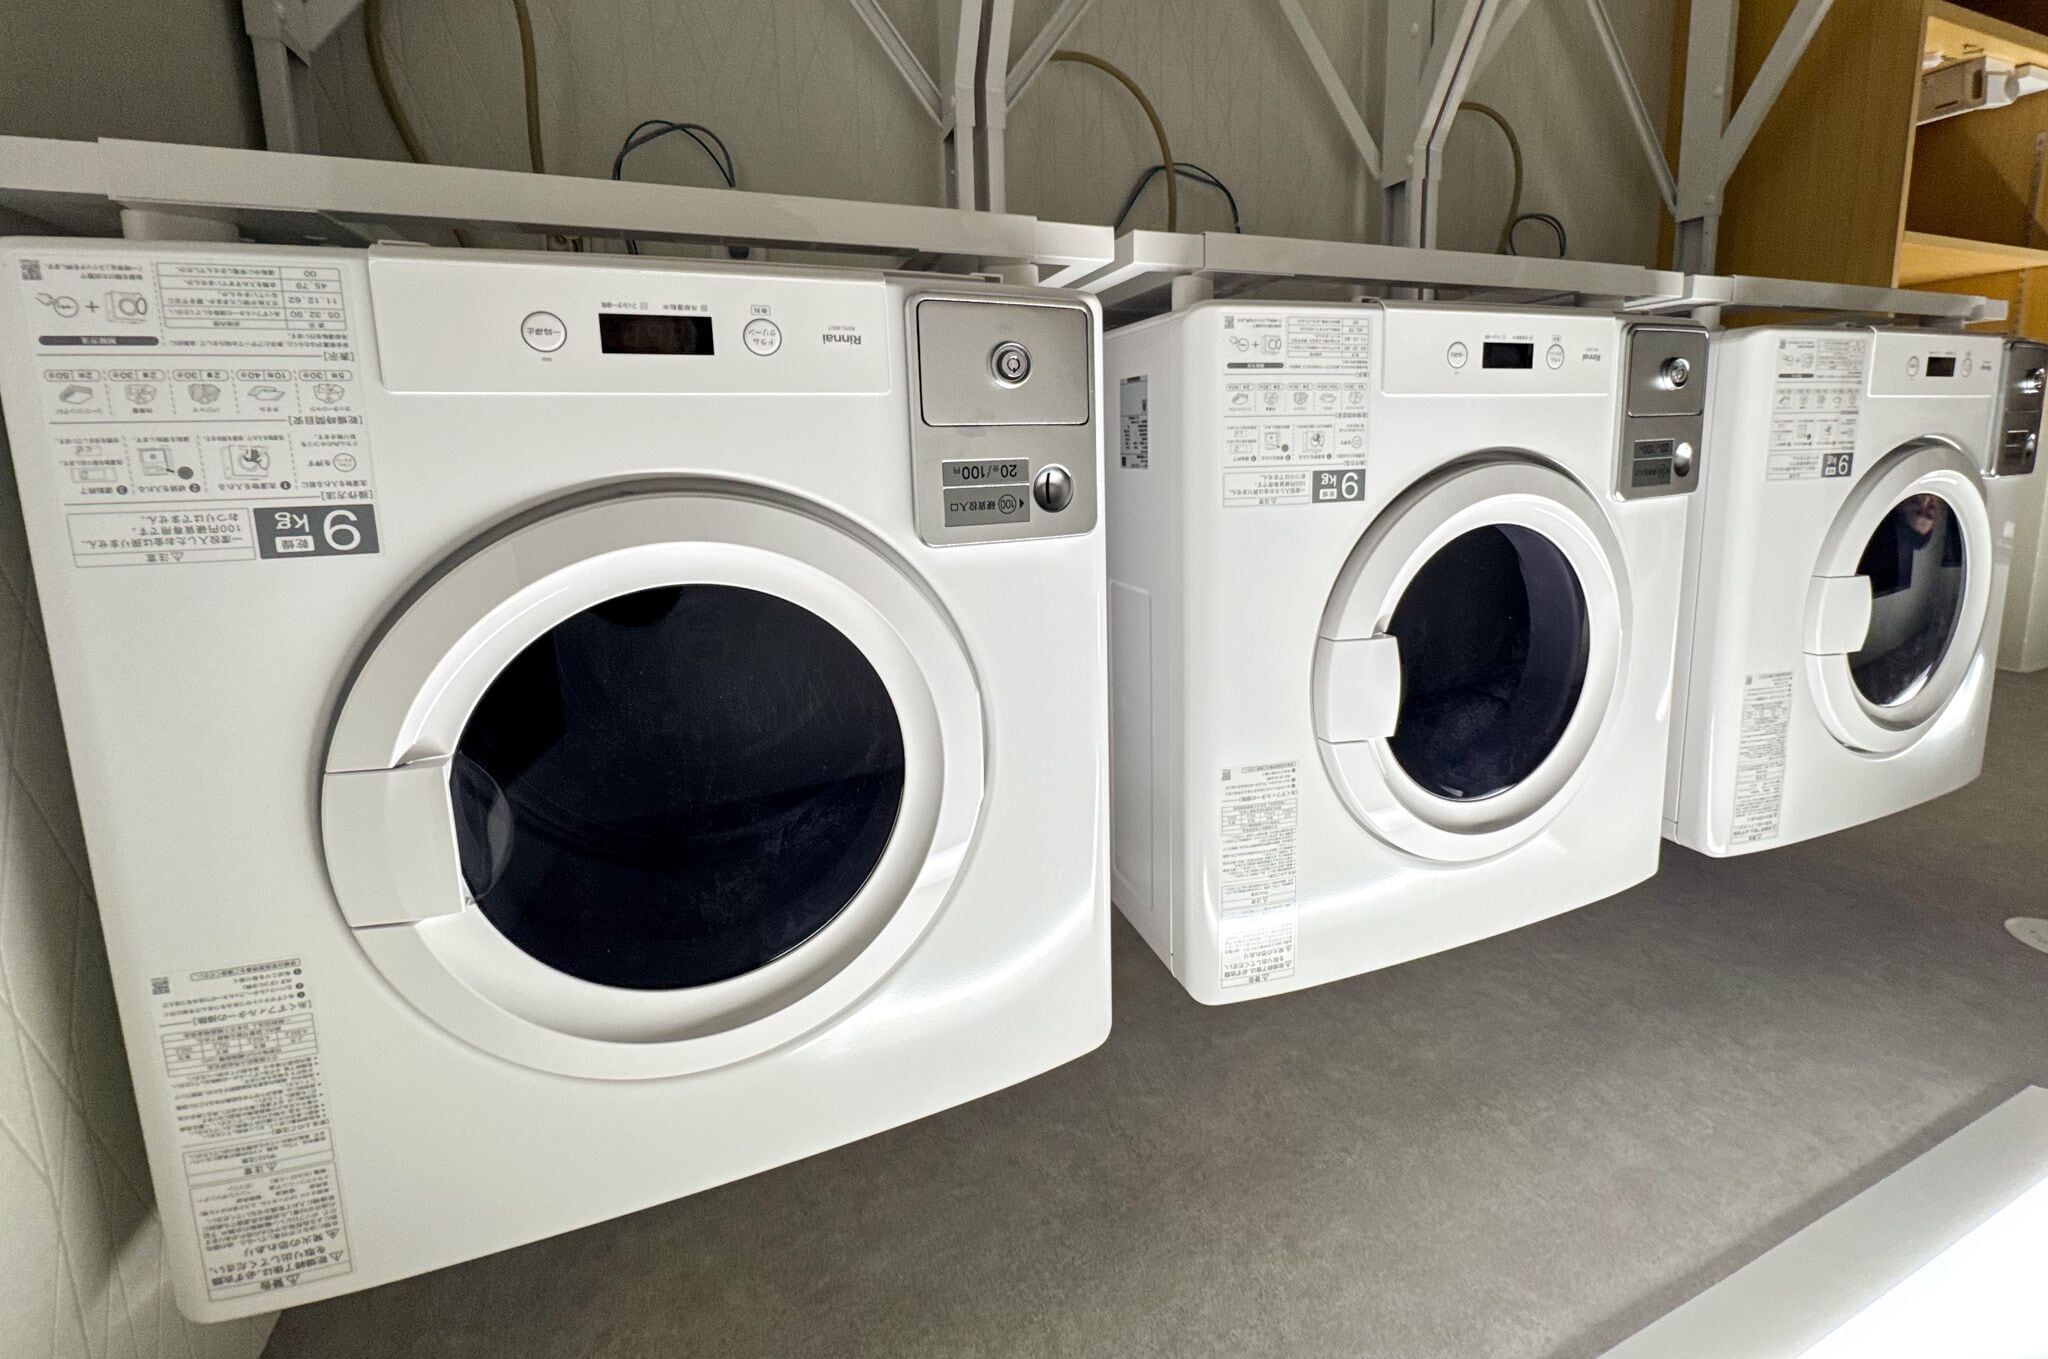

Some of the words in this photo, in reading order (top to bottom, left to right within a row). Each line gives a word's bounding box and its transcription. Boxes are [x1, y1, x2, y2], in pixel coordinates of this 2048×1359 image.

[526, 326, 561, 336] 一時停止
[752, 337, 775, 346] ドラム
[821, 333, 862, 346] Rinnai
[1838, 454, 1850, 476] 9
[1320, 473, 1337, 487] kg
[1341, 472, 1359, 499] 9
[949, 500, 996, 511] 硬貨投入口
[138, 513, 239, 525] おつりはでません。
[273, 510, 310, 533] kg
[130, 524, 241, 537] 100円硬貨専用です。
[324, 509, 362, 551] 9
[81, 535, 244, 549] 一度投入したお金は戻りません。
[281, 538, 311, 551] 乾燥
